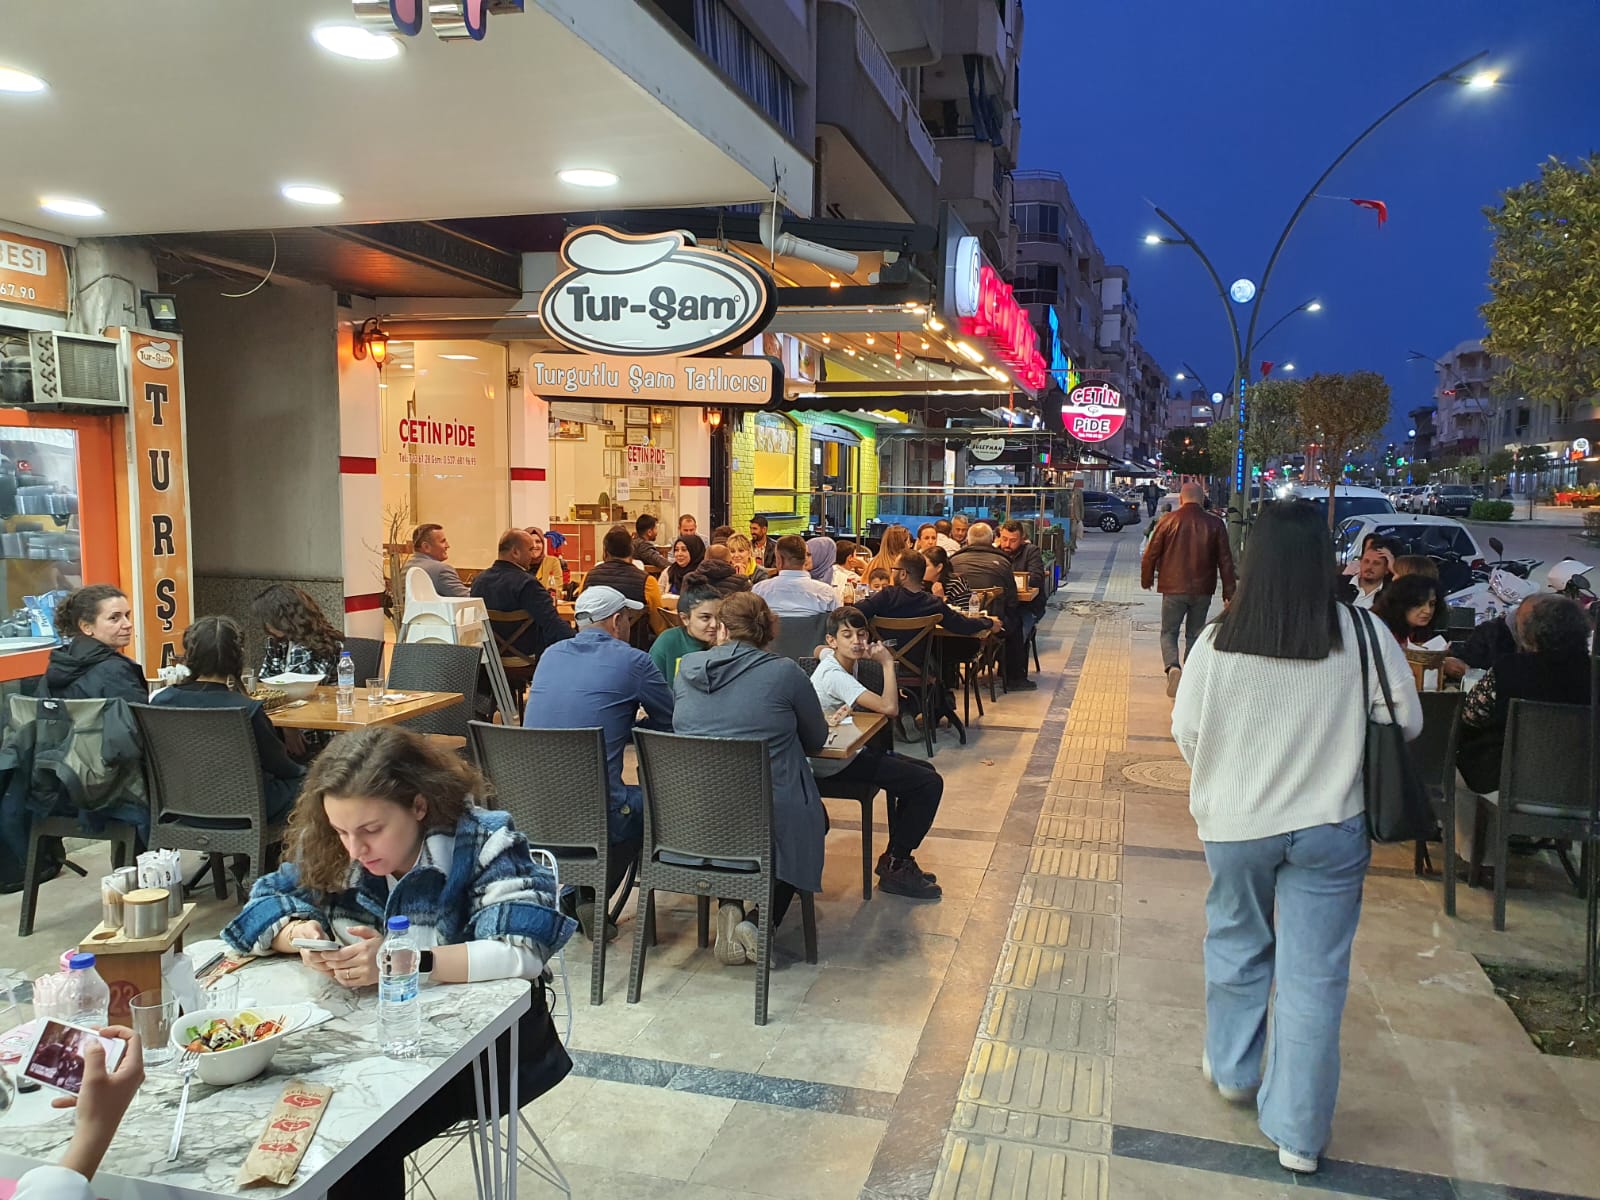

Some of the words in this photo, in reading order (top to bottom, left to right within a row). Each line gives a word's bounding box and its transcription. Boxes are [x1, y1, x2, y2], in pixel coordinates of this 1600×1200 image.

[566, 285, 736, 330] Tur-Şam
[534, 362, 620, 392] Turgutlu
[628, 364, 676, 393] Şam
[684, 367, 767, 393] Tatlıcısı
[1071, 384, 1120, 406] ÇETİN
[399, 416, 442, 448] ÇETİN
[445, 418, 476, 447] PİDE
